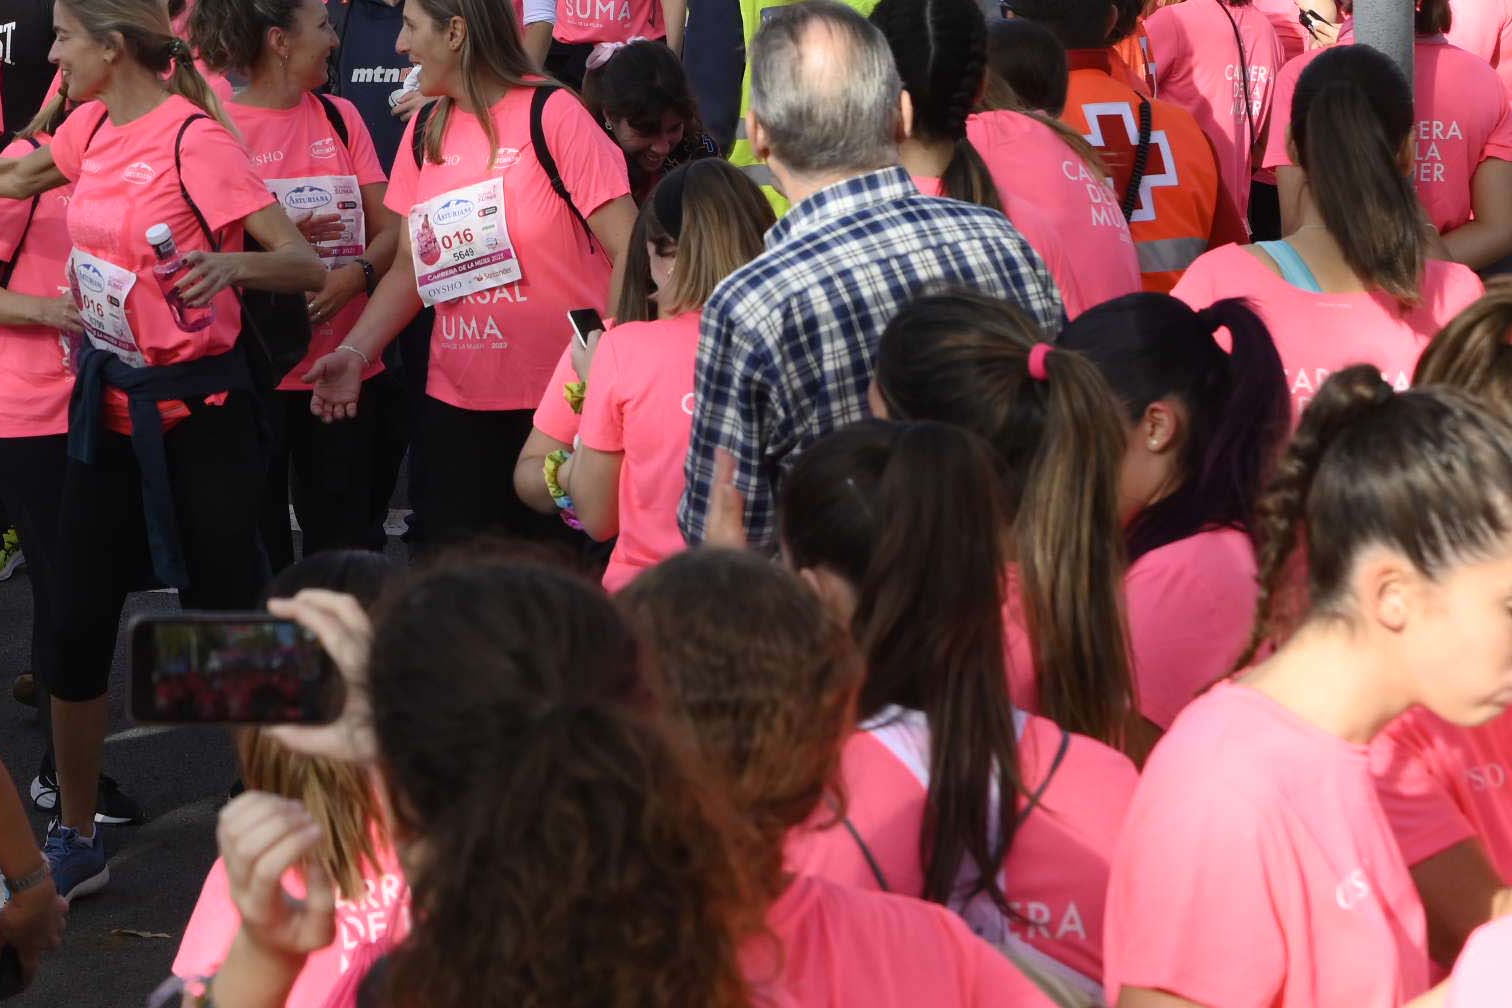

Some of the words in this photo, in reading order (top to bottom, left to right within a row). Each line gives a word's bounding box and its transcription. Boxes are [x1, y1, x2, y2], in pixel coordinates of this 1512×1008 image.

[441, 228, 474, 250] 016
[453, 248, 475, 262] 5649
[428, 281, 463, 298] OYSHO
